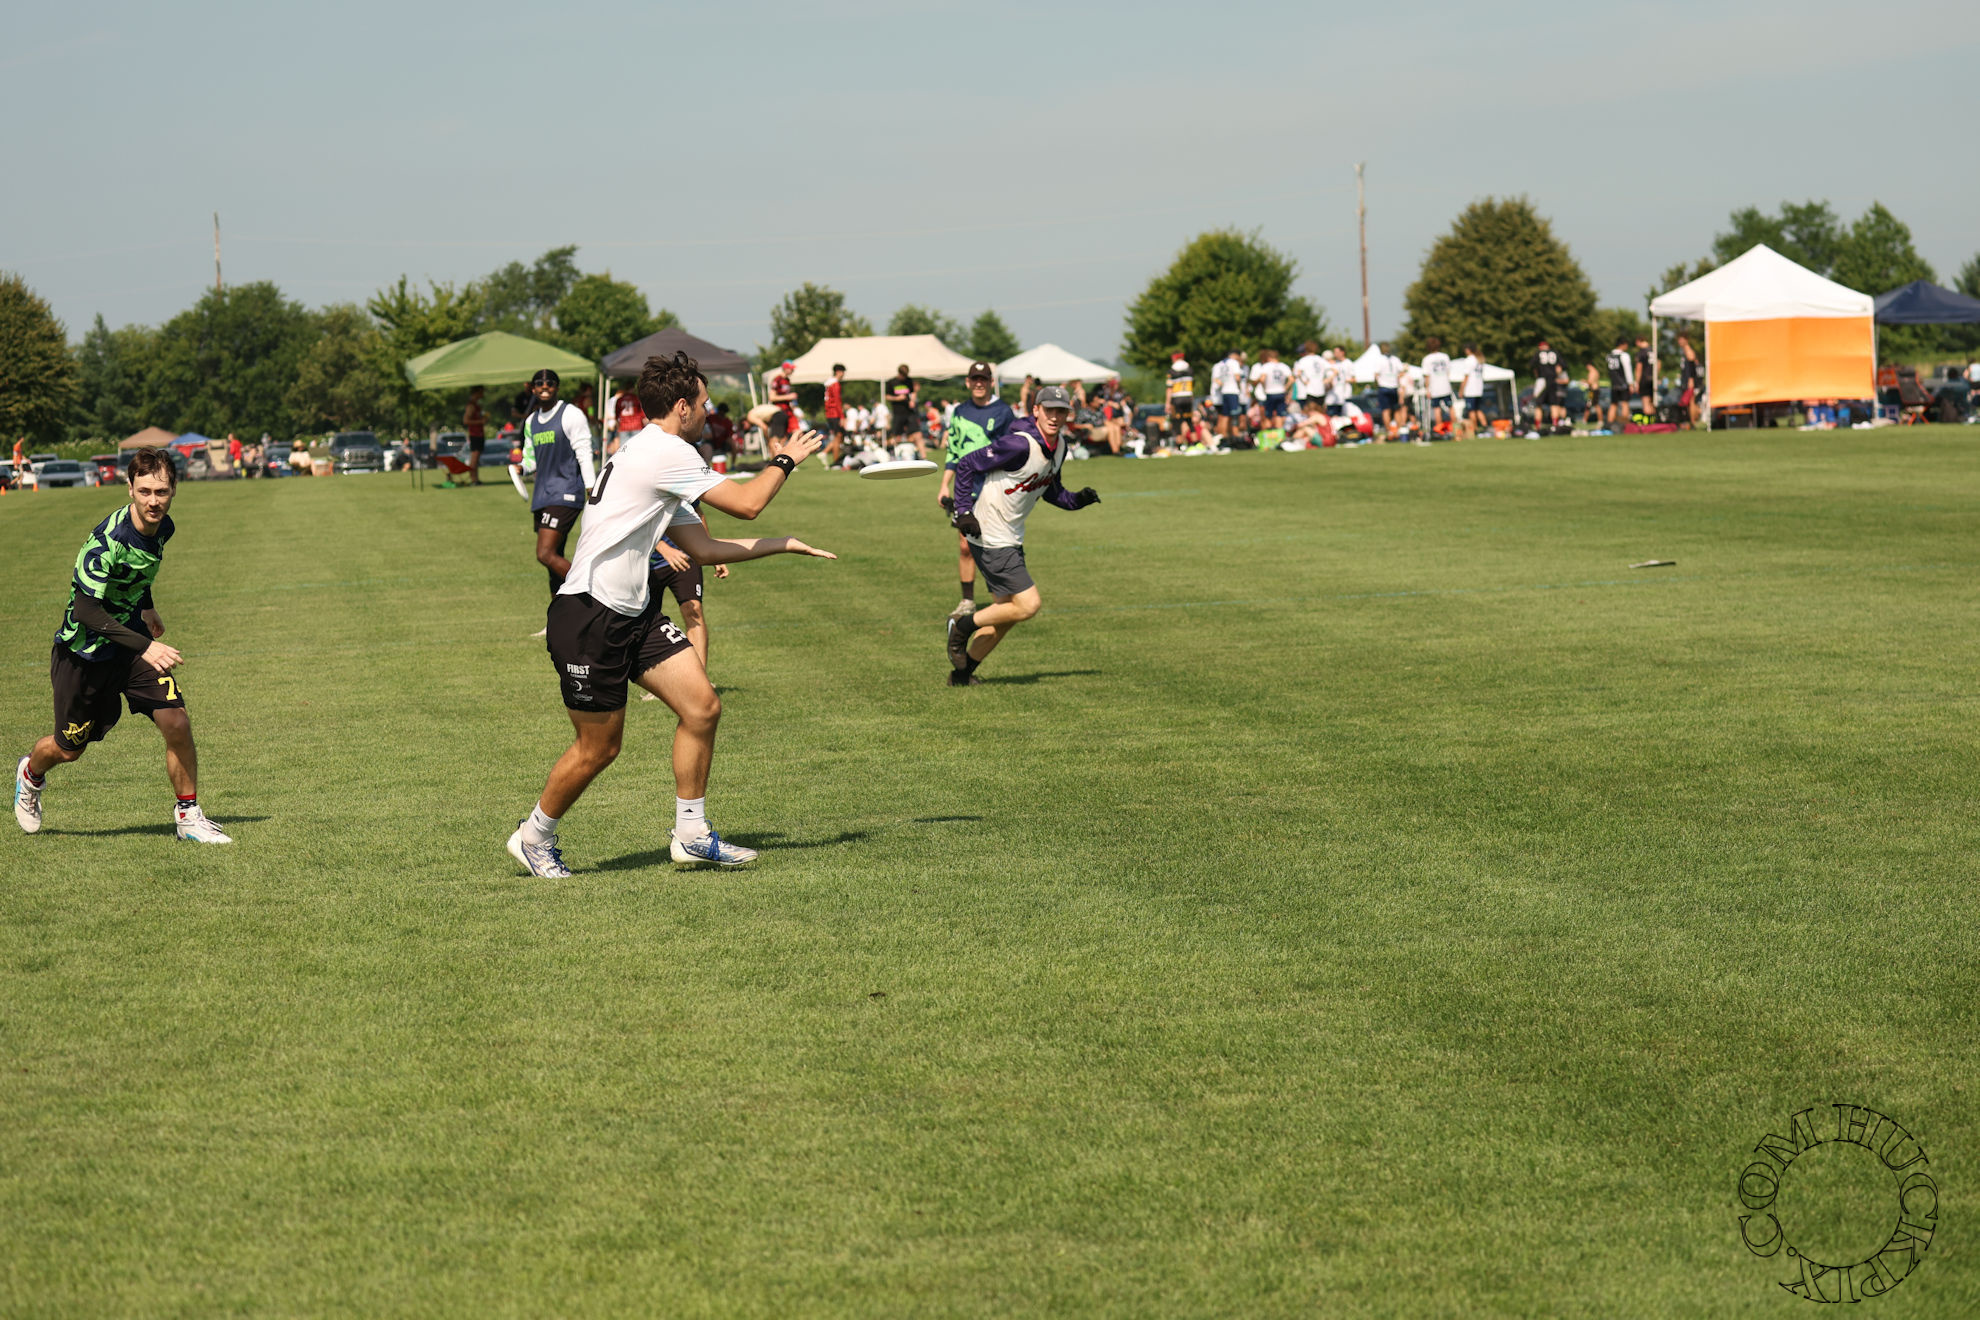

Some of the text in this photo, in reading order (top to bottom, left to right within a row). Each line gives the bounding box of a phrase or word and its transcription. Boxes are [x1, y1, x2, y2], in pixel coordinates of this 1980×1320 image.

[541, 512, 551, 525] 21
[695, 583, 702, 597] 9
[567, 664, 589, 675] FIRST
